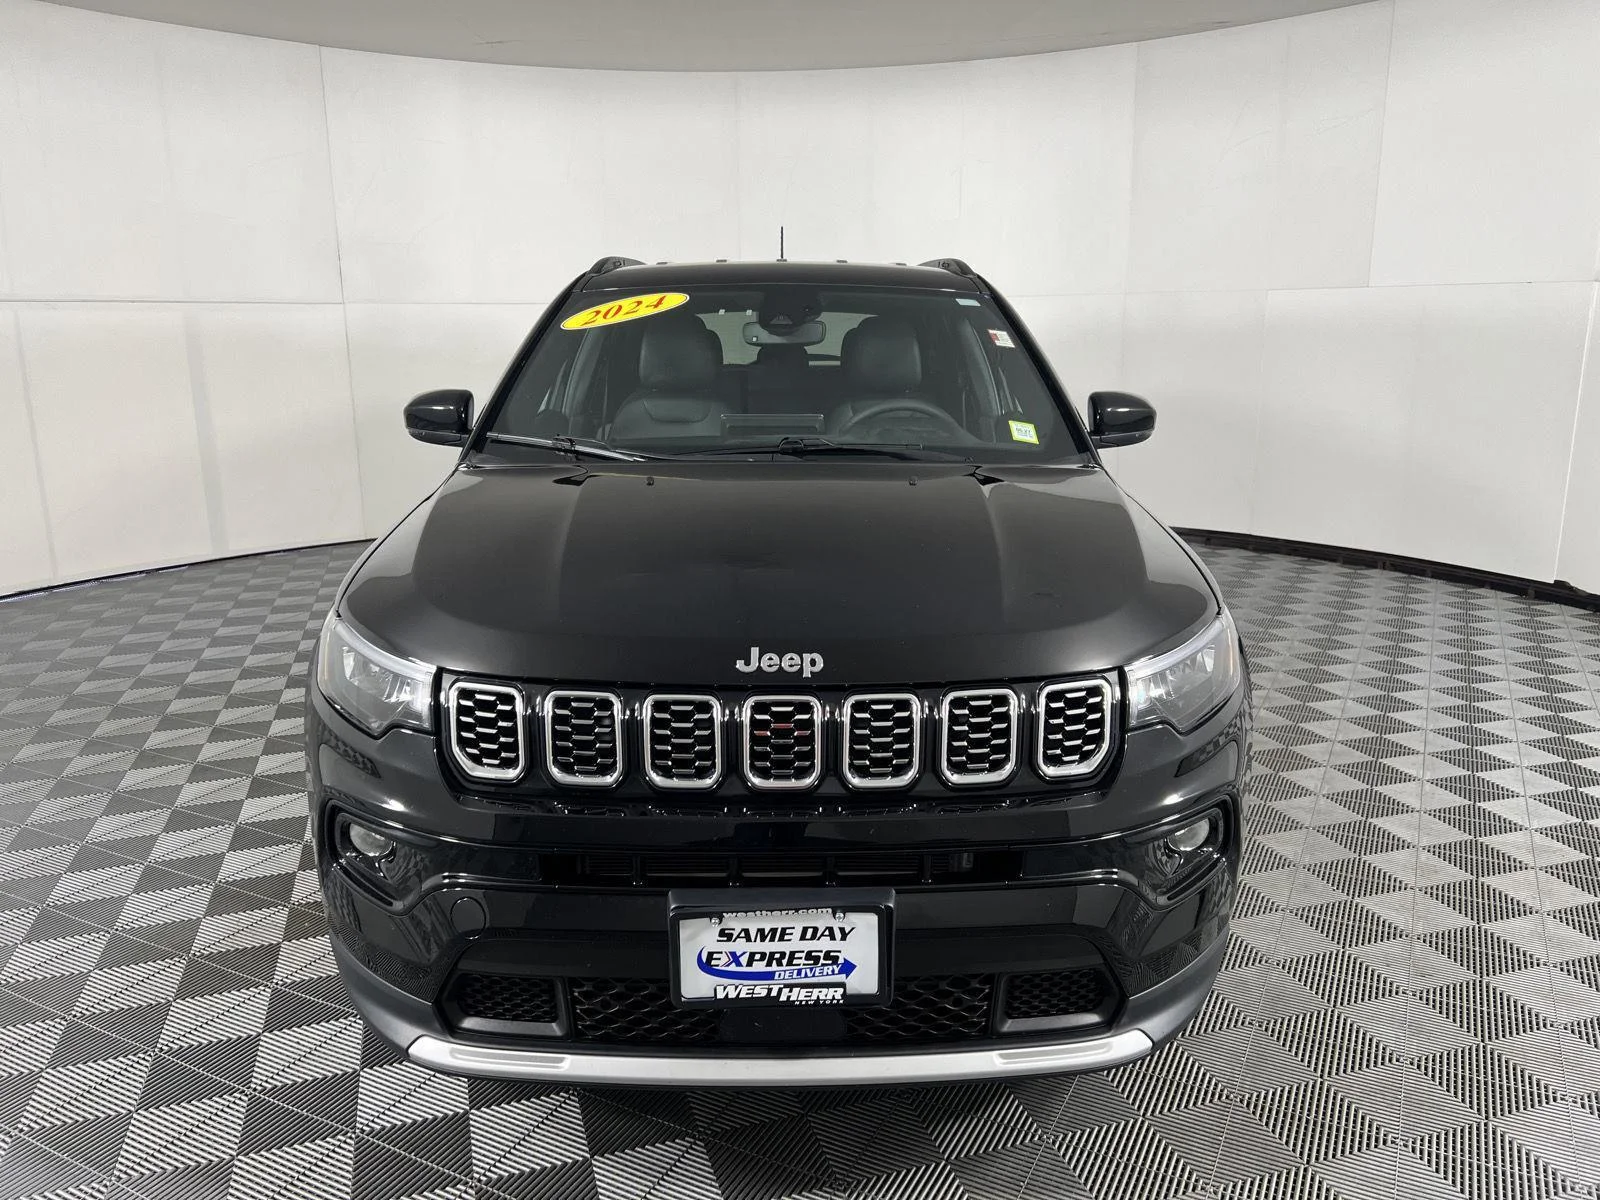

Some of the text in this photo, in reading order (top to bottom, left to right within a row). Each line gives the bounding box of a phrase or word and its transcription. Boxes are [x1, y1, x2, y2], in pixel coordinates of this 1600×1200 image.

[580, 295, 668, 327] 2024
[735, 646, 824, 678] Jeep
[722, 907, 833, 919] westherr.com
[716, 925, 857, 943] SAME DAY
[704, 949, 843, 968] EXPRESS
[773, 963, 843, 981] DELIVERY
